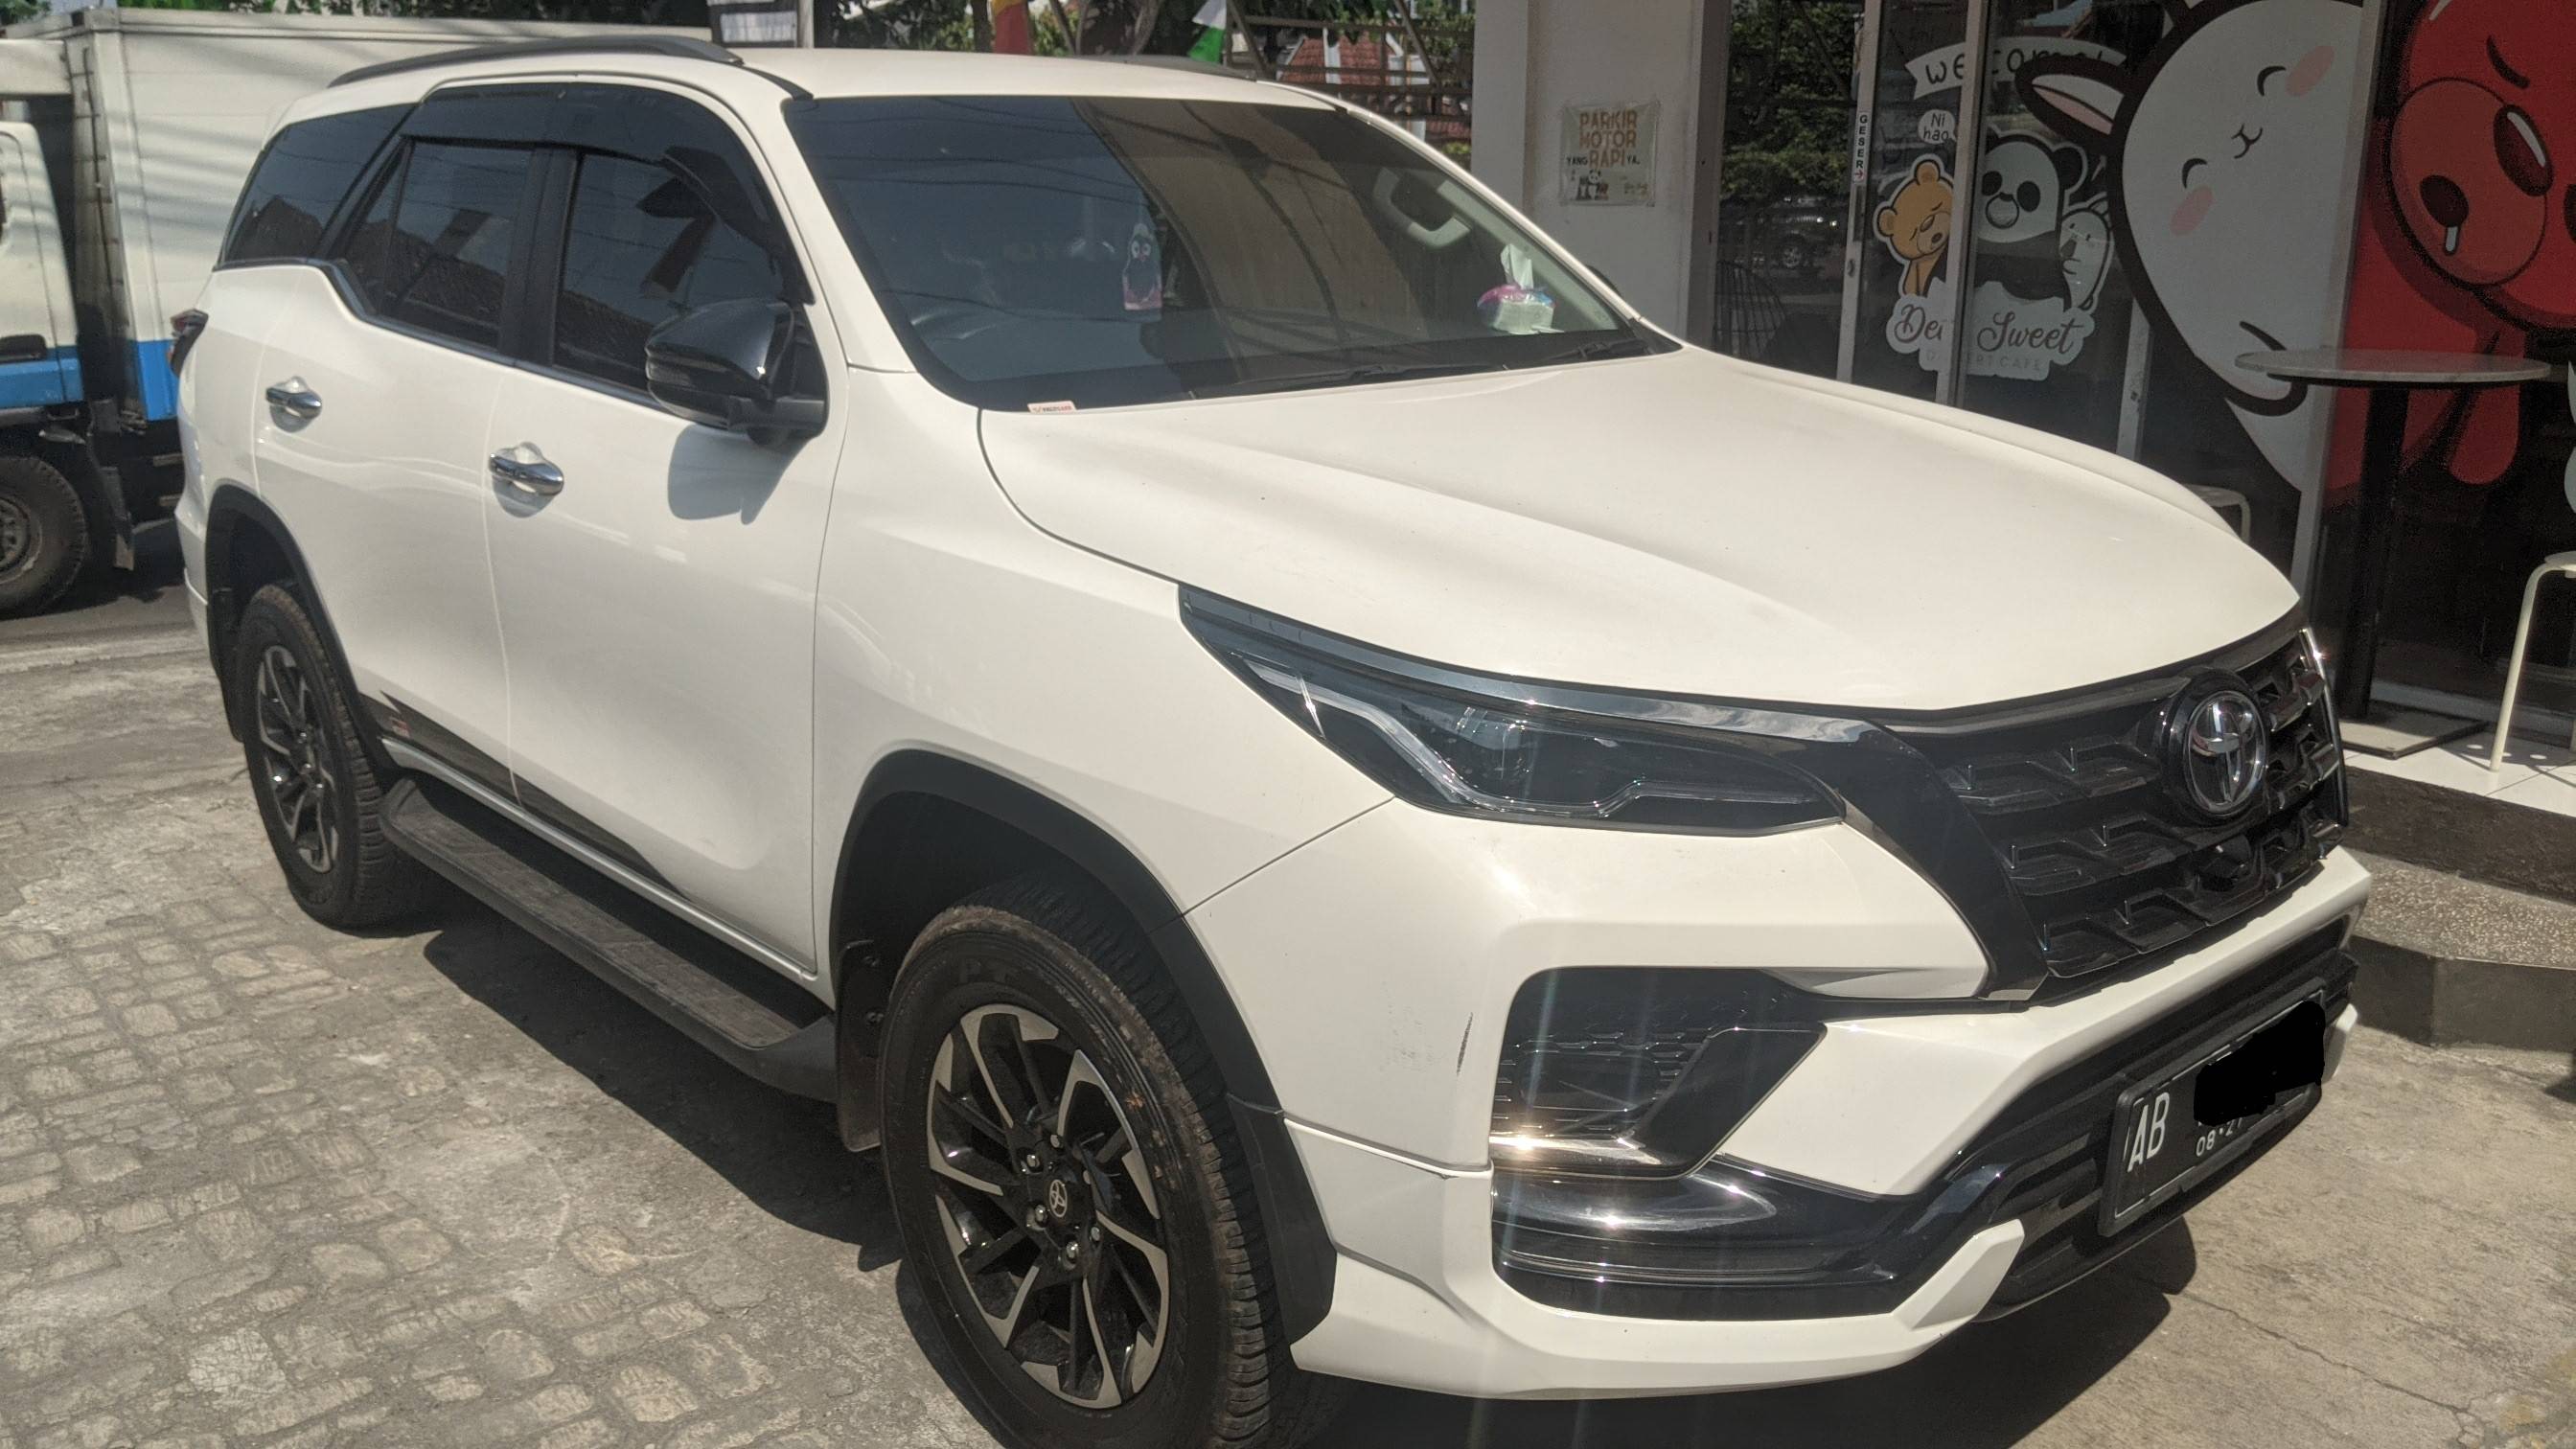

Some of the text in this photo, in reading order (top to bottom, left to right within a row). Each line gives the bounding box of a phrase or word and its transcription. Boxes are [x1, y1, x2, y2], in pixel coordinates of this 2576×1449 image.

[1579, 109, 1637, 129] PARKIR
[1931, 113, 1945, 127] Ni
[1579, 129, 1636, 149] MOTOR
[1856, 115, 1868, 169] GESER
[1590, 149, 1625, 169] RAPI
[1894, 304, 2084, 354] De Sweet
[2128, 1092, 2170, 1172] AB
